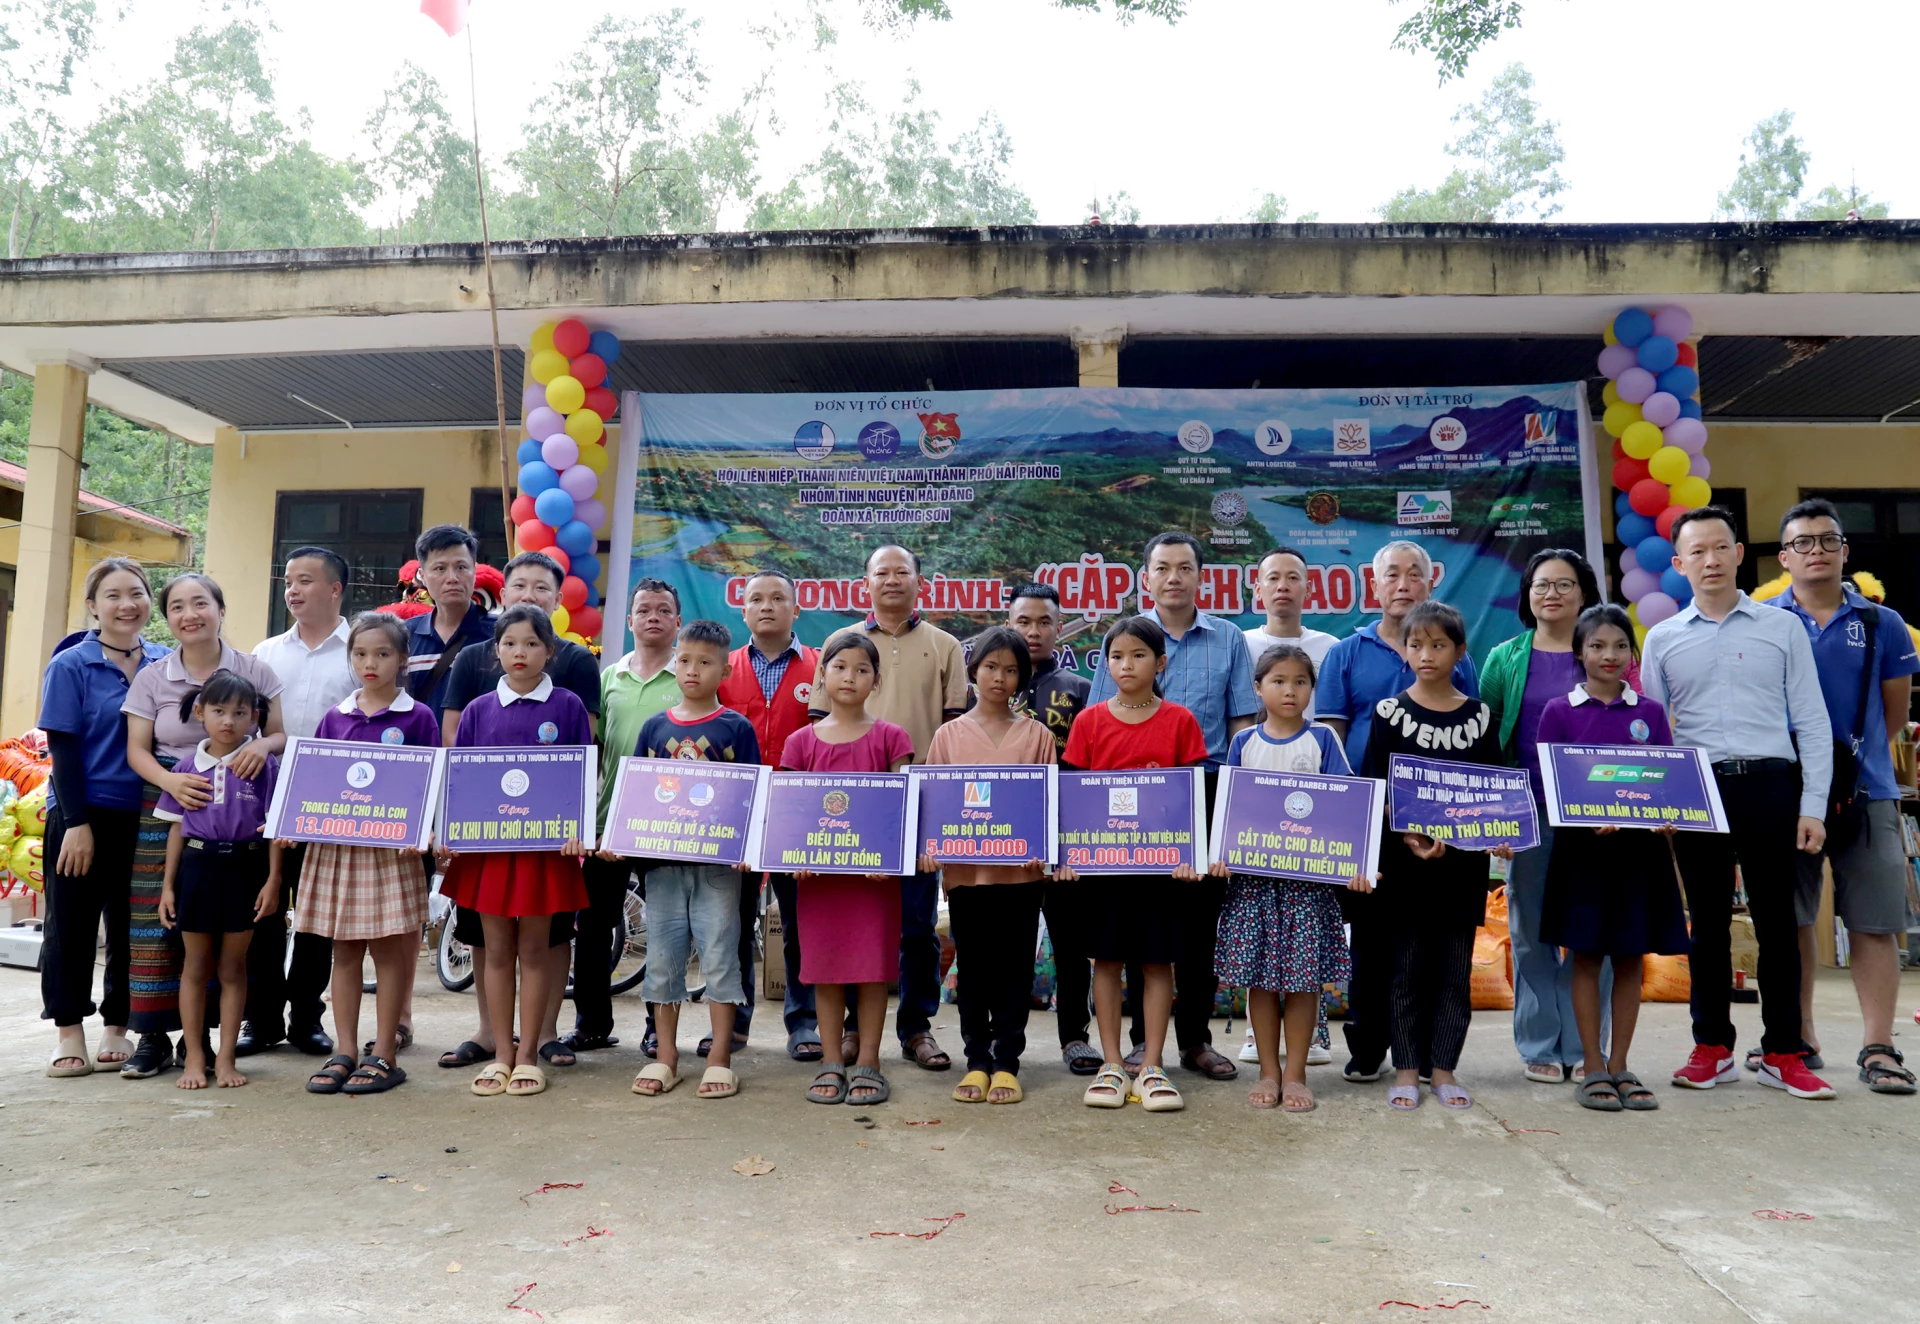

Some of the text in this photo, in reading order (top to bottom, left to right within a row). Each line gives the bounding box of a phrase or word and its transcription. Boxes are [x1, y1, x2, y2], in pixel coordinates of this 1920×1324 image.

[814, 395, 932, 413] ĐƠN VỊ TỔ CHỨC
[1358, 392, 1473, 408] ĐƠN VỊ TÀI TRỢ
[1329, 460, 1348, 468] NHÓM
[1350, 459, 1363, 468] LIÊN
[718, 461, 1061, 486] HỘI LIÊN HIỆP THANH NIÊN VIỆT NAM THÀNH PHỐ HẢI PHÒNG
[800, 484, 973, 505] NHÓM TÌNH NGUYỆN HẢI ĐĂNG
[822, 506, 950, 522] ĐOÀN XÃ TRƯỜNG SƠN
[1413, 514, 1429, 522] VIỆT
[1563, 746, 1584, 755] CÔNG
[1595, 748, 1616, 756] TNHH
[1617, 749, 1649, 757] KOSAME
[1649, 748, 1665, 759] VIỆT
[1012, 772, 1029, 780] QUANG
[1081, 774, 1165, 786] ĐOÀN TỪ THIỆN LIÊN HOA
[1254, 776, 1349, 792] HOÀNG HIẾU BARBER SHOP
[1394, 763, 1525, 791] CÔNG TY TNHH THƯƠNG MẠI & SẢN XUẤT
[340, 790, 372, 803] Tặng
[1417, 783, 1435, 800] XUẤT
[1436, 788, 1454, 805] NHẬP
[1475, 793, 1484, 802] VY
[1485, 793, 1503, 802] LINH
[1615, 789, 1651, 800] Tặng
[301, 801, 408, 819] 760KG GẠO CHO BÀ CON
[497, 804, 530, 816] Tặng
[668, 805, 699, 817] Tặng
[961, 809, 993, 820] Tặng
[1444, 807, 1482, 818] Tặng
[1564, 803, 1581, 816] 160
[1583, 803, 1605, 817] CHAI
[1633, 807, 1641, 818] &
[1642, 806, 1660, 819] 260
[1661, 806, 1680, 822] HỘP
[1682, 806, 1709, 822] BÁNH
[295, 816, 407, 839] 13.000.000Đ
[449, 814, 578, 840] 02 KHU VUI CHƠI CHO TRẺ EM
[626, 817, 735, 839] 1000 QUYỂN VỞ & SÁCH
[818, 817, 850, 829] Tặng
[942, 822, 1011, 838] 500 BỘ CHƠI
[1107, 818, 1139, 830] Tặng
[1279, 820, 1312, 835] Tặng
[1426, 825, 1454, 839] CON
[1456, 821, 1481, 838] THÚ
[1484, 818, 1520, 838] BÔNG
[806, 828, 860, 847] BIỂU DIỄN
[1142, 832, 1147, 844] &
[1237, 827, 1353, 857] CẮT TÓC CHO BÀ CON
[634, 836, 720, 856] TRUYỆN THIẾU NHI
[926, 839, 1028, 856] 5.000.000Đ
[782, 848, 807, 864] MÚA
[810, 848, 831, 865] LÂN
[834, 850, 850, 865] SƯ
[1067, 847, 1180, 866] 20.000.000Đ
[1228, 848, 1358, 877] VÀ CÁC CHÁU THIẾU NHI
